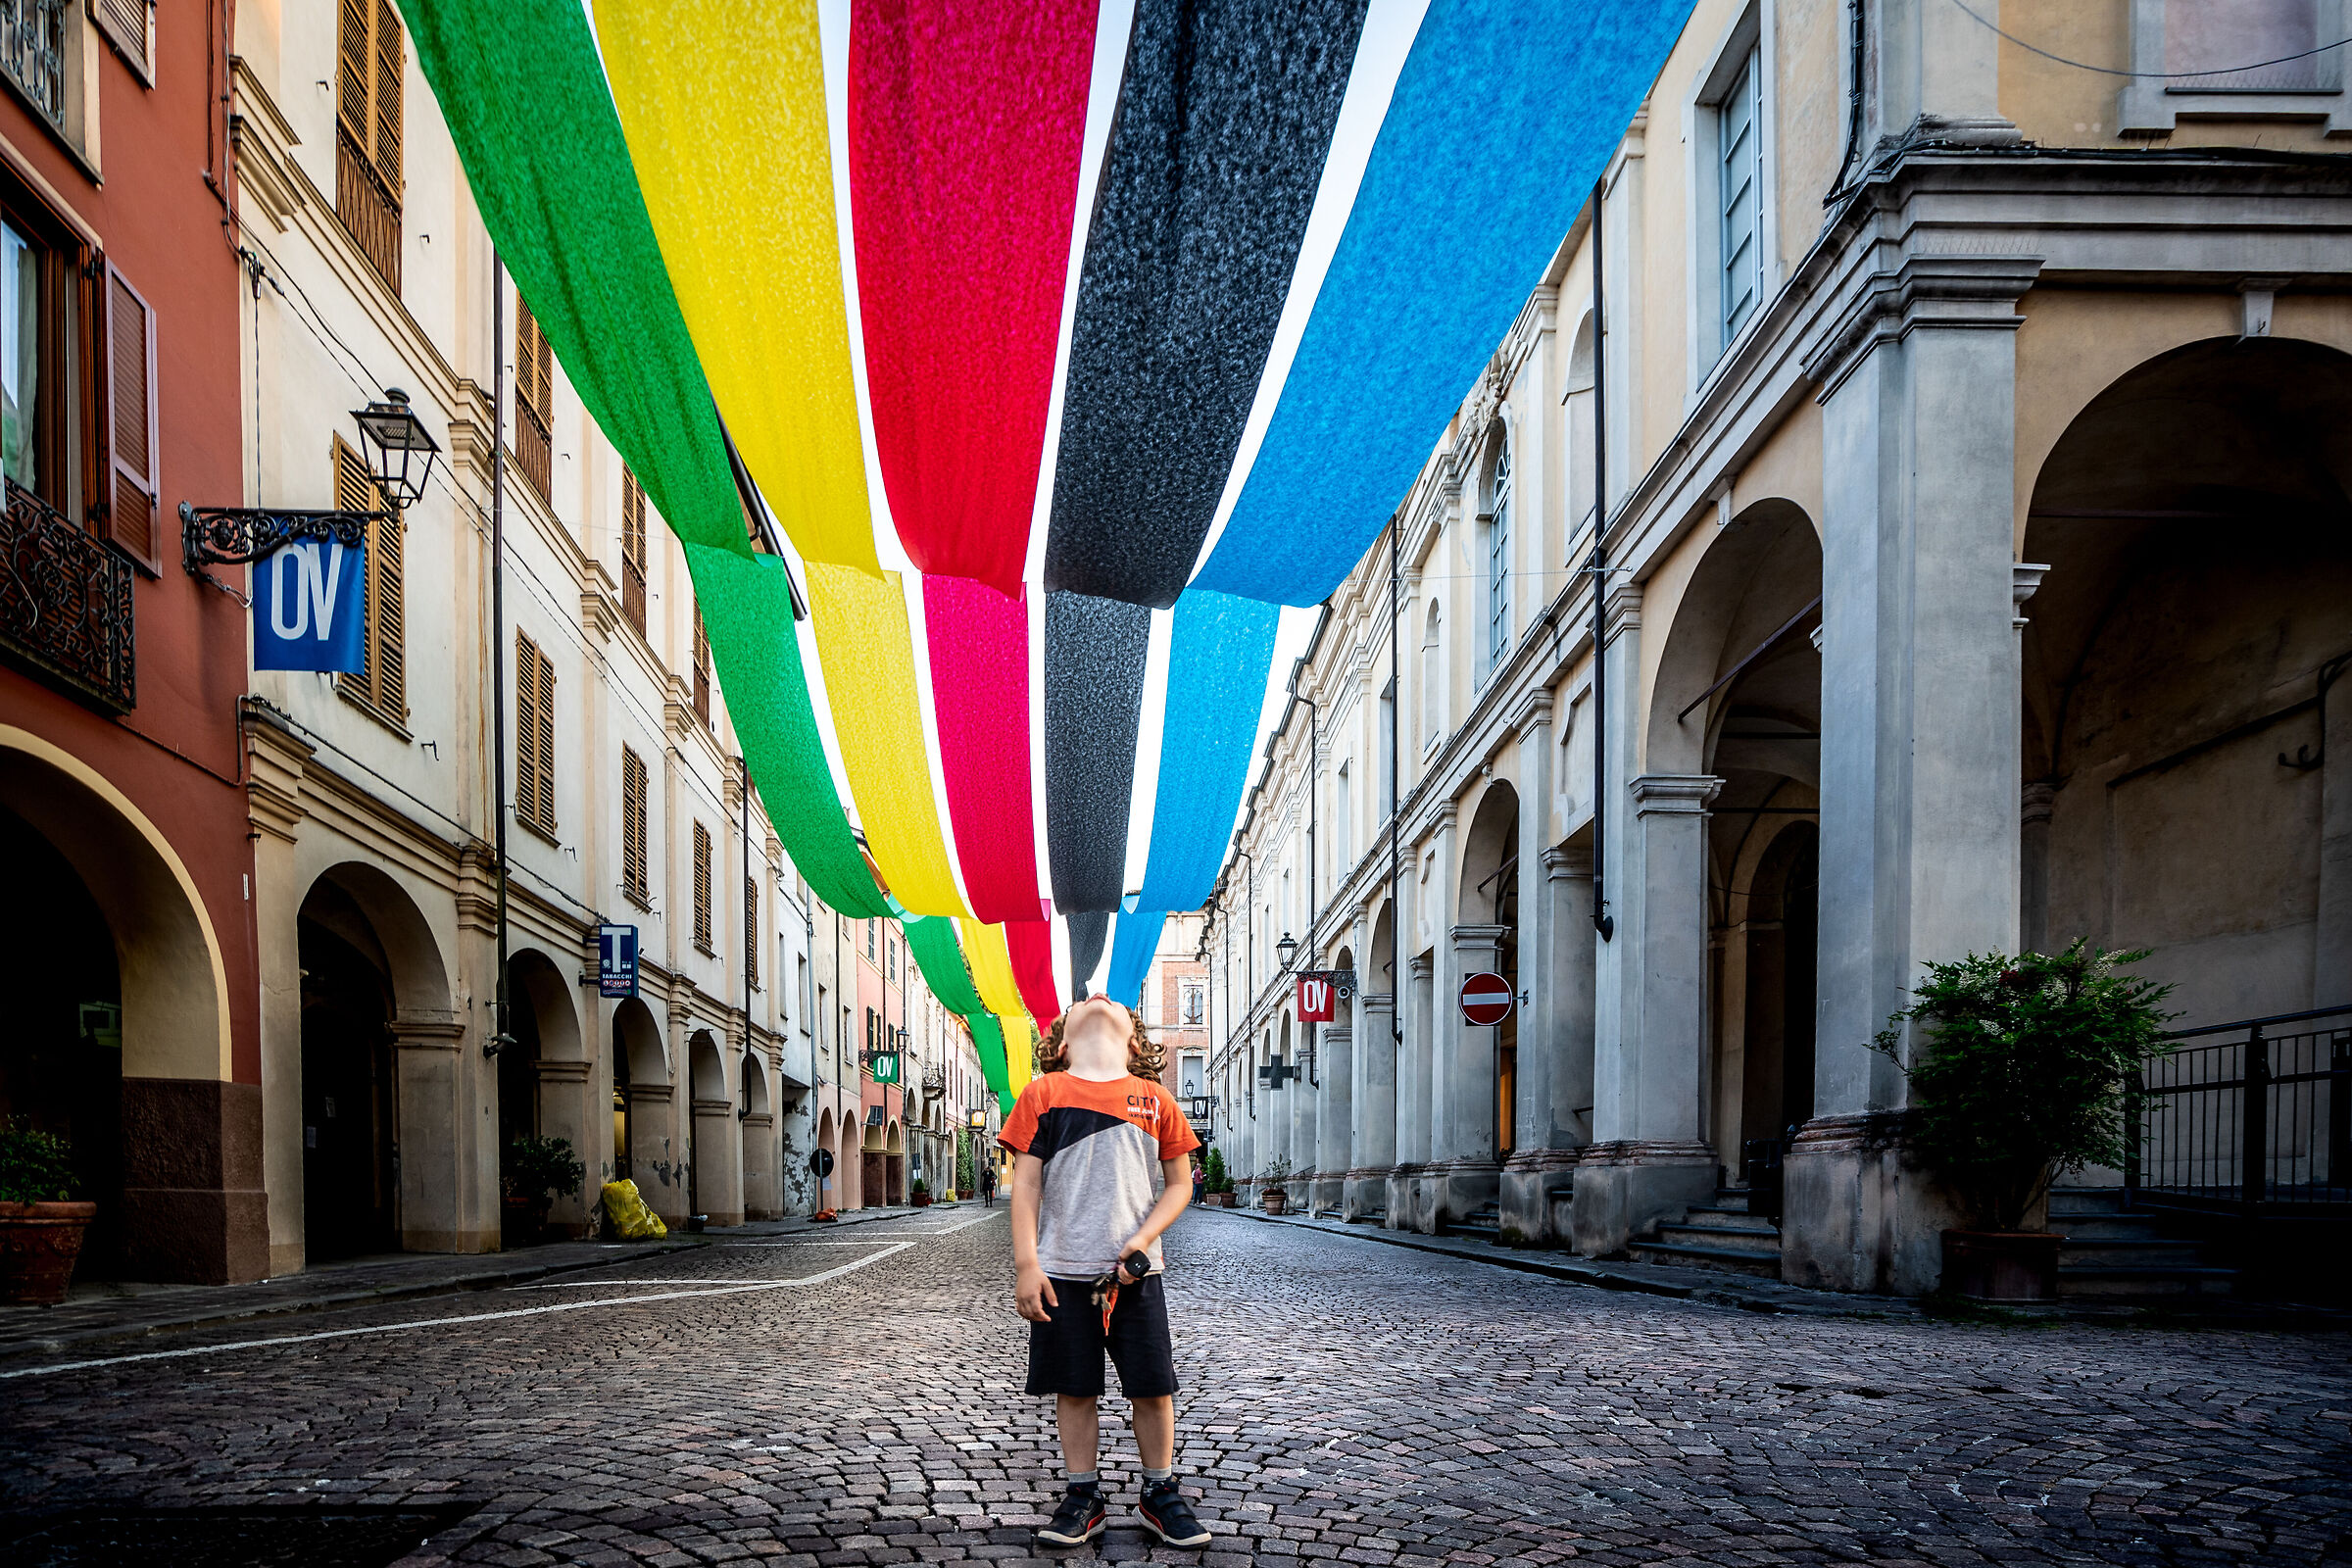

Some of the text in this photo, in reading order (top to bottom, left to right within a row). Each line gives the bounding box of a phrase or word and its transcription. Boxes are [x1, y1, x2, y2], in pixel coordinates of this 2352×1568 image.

[270, 542, 344, 641] OV
[601, 926, 632, 973] T
[1303, 980, 1328, 1013] OV
[877, 1056, 893, 1077] OV
[1195, 1100, 1206, 1115] OV
